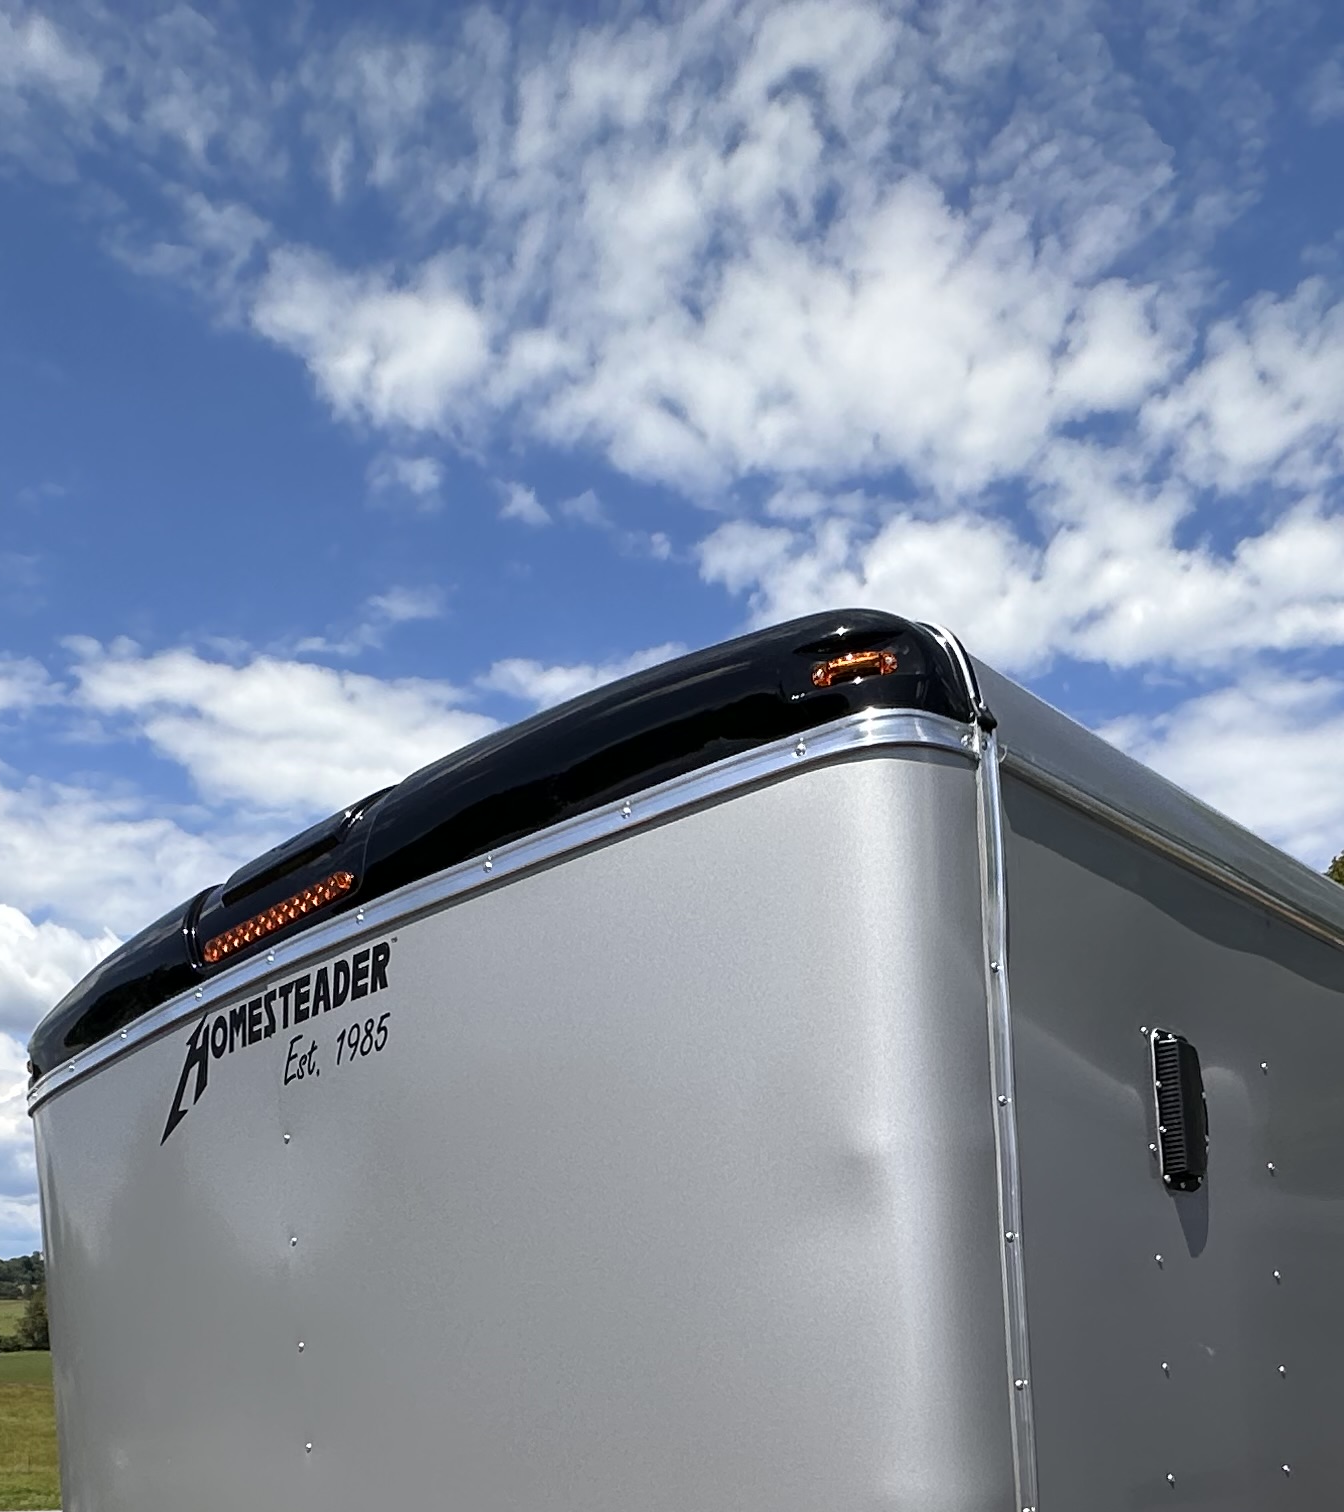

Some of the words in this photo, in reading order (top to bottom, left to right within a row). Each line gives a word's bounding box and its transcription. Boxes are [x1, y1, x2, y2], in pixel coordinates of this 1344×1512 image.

[160, 942, 391, 1147] HOMESTEADER
[283, 1034, 320, 1086] Est.
[336, 1012, 391, 1066] 1985
